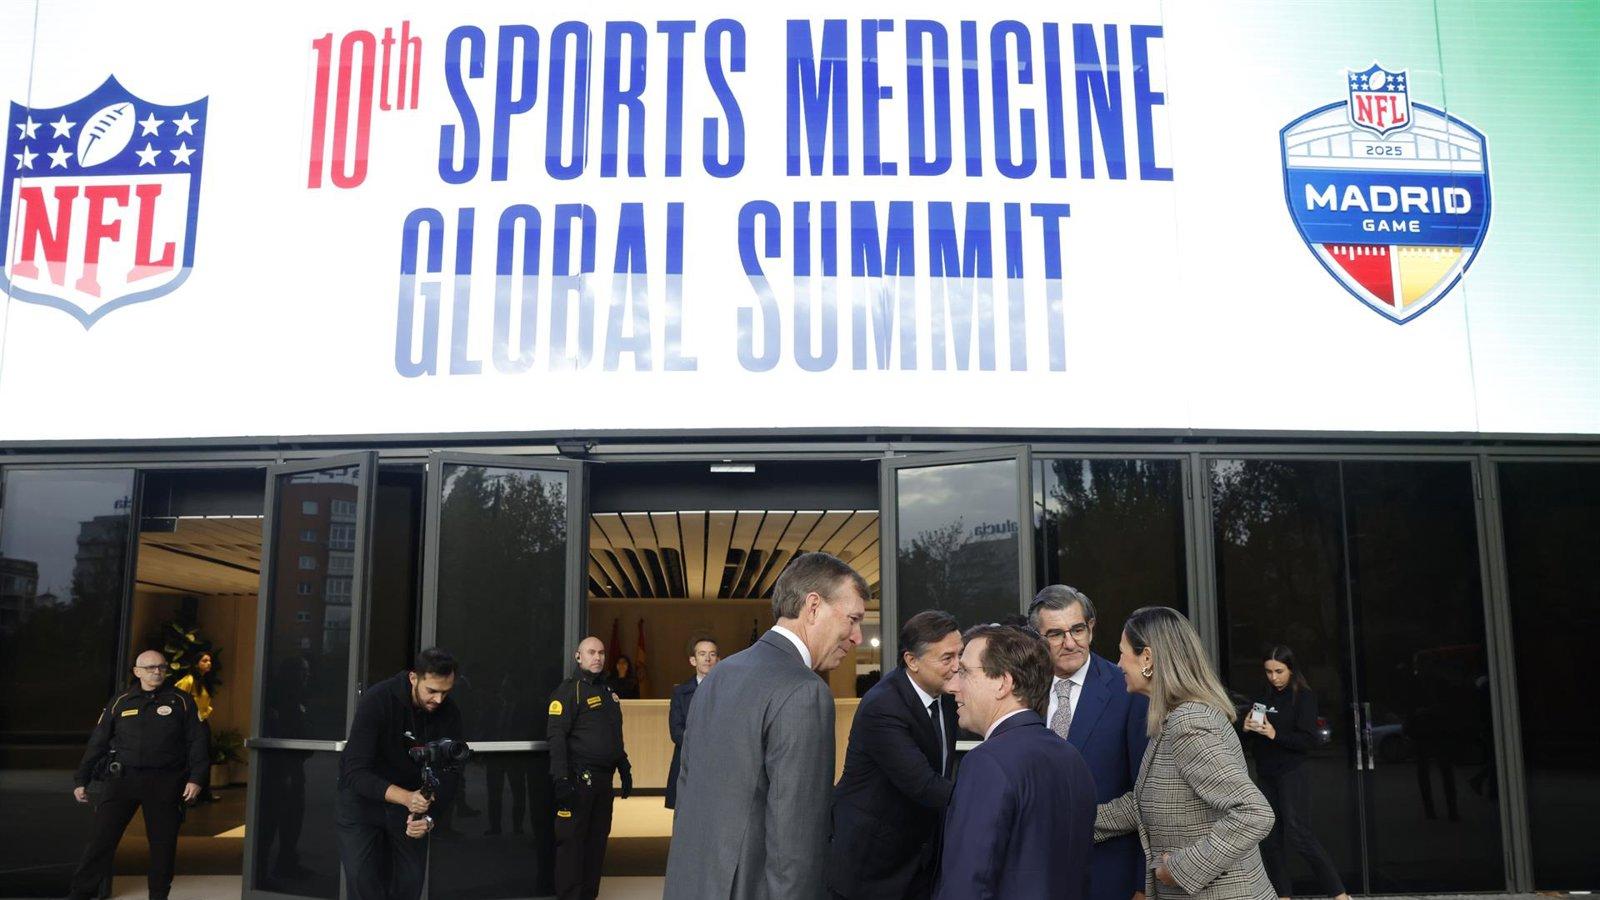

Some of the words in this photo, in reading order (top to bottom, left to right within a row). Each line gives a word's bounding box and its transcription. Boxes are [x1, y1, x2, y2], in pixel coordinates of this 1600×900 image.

[308, 20, 422, 189] 10th
[438, 18, 746, 185] SPORTS
[786, 18, 1174, 182] MEDICINE
[1355, 94, 1404, 128] NFL
[1365, 145, 1403, 156] 2025
[1304, 183, 1472, 215] MADRID
[11, 183, 177, 299] NFL
[1362, 218, 1421, 233] GAME
[394, 202, 698, 378] GLOBAL
[737, 200, 1071, 373] SUMMIT
